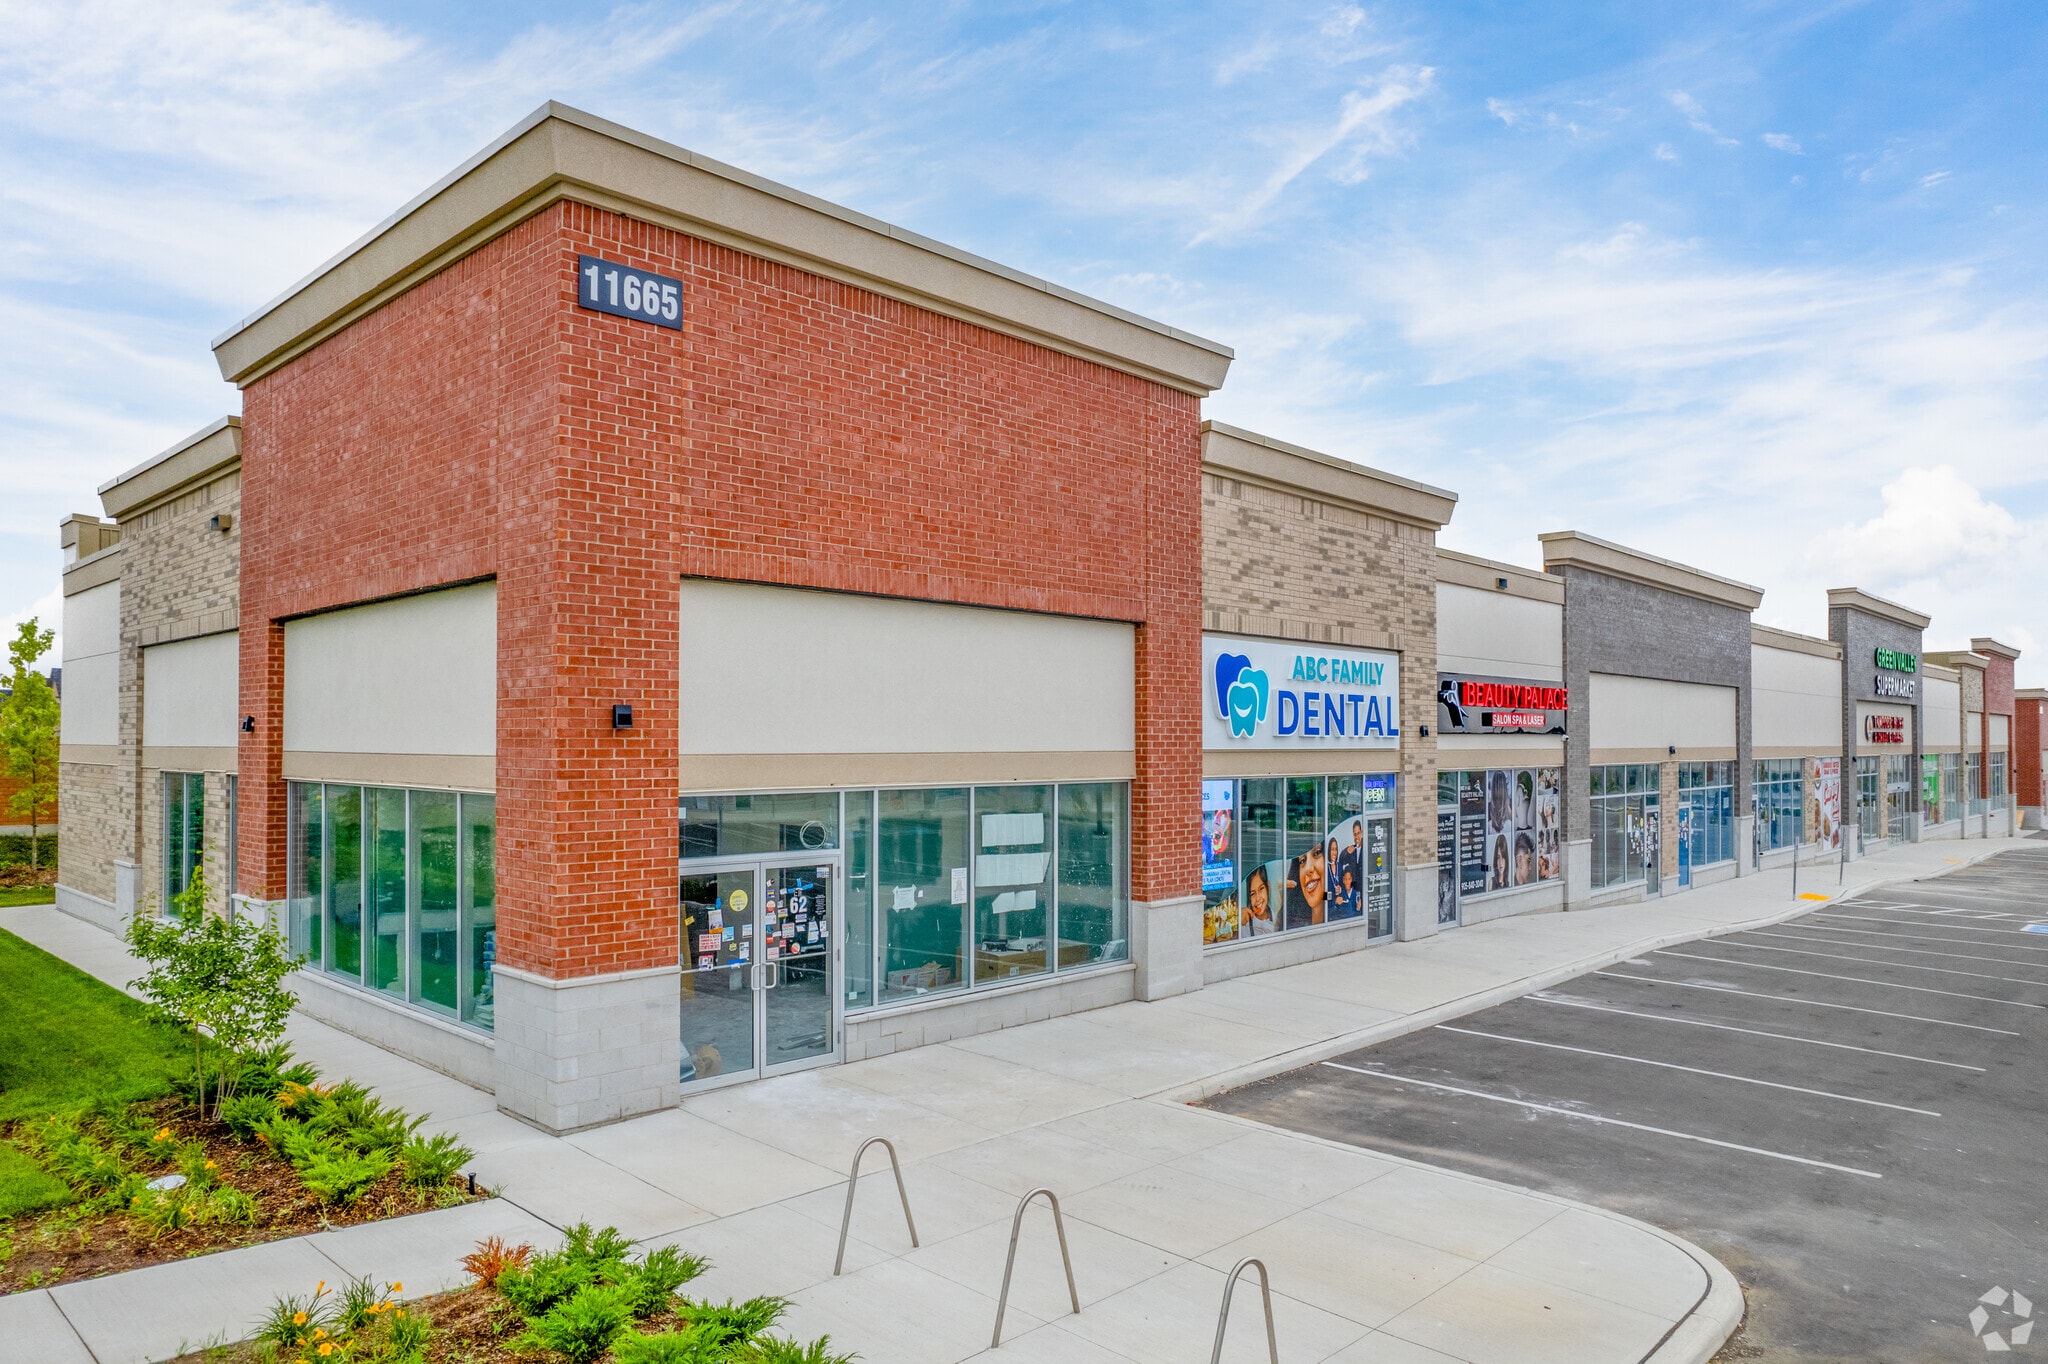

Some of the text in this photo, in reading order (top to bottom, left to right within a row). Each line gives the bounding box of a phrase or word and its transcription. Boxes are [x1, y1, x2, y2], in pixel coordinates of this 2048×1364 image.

[585, 265, 678, 320] 11665
[1292, 655, 1384, 685] ABC FAMILY
[1876, 647, 1917, 673] GREEN VALLEY
[1465, 682, 1568, 710] BEAUTY PALACE
[1876, 675, 1915, 698] SUPERMARKET
[1278, 690, 1399, 736] DENTAL
[1492, 714, 1511, 724] SALON
[1512, 714, 1523, 725] SPA
[1527, 715, 1545, 725] LASER
[789, 896, 808, 914] 62
